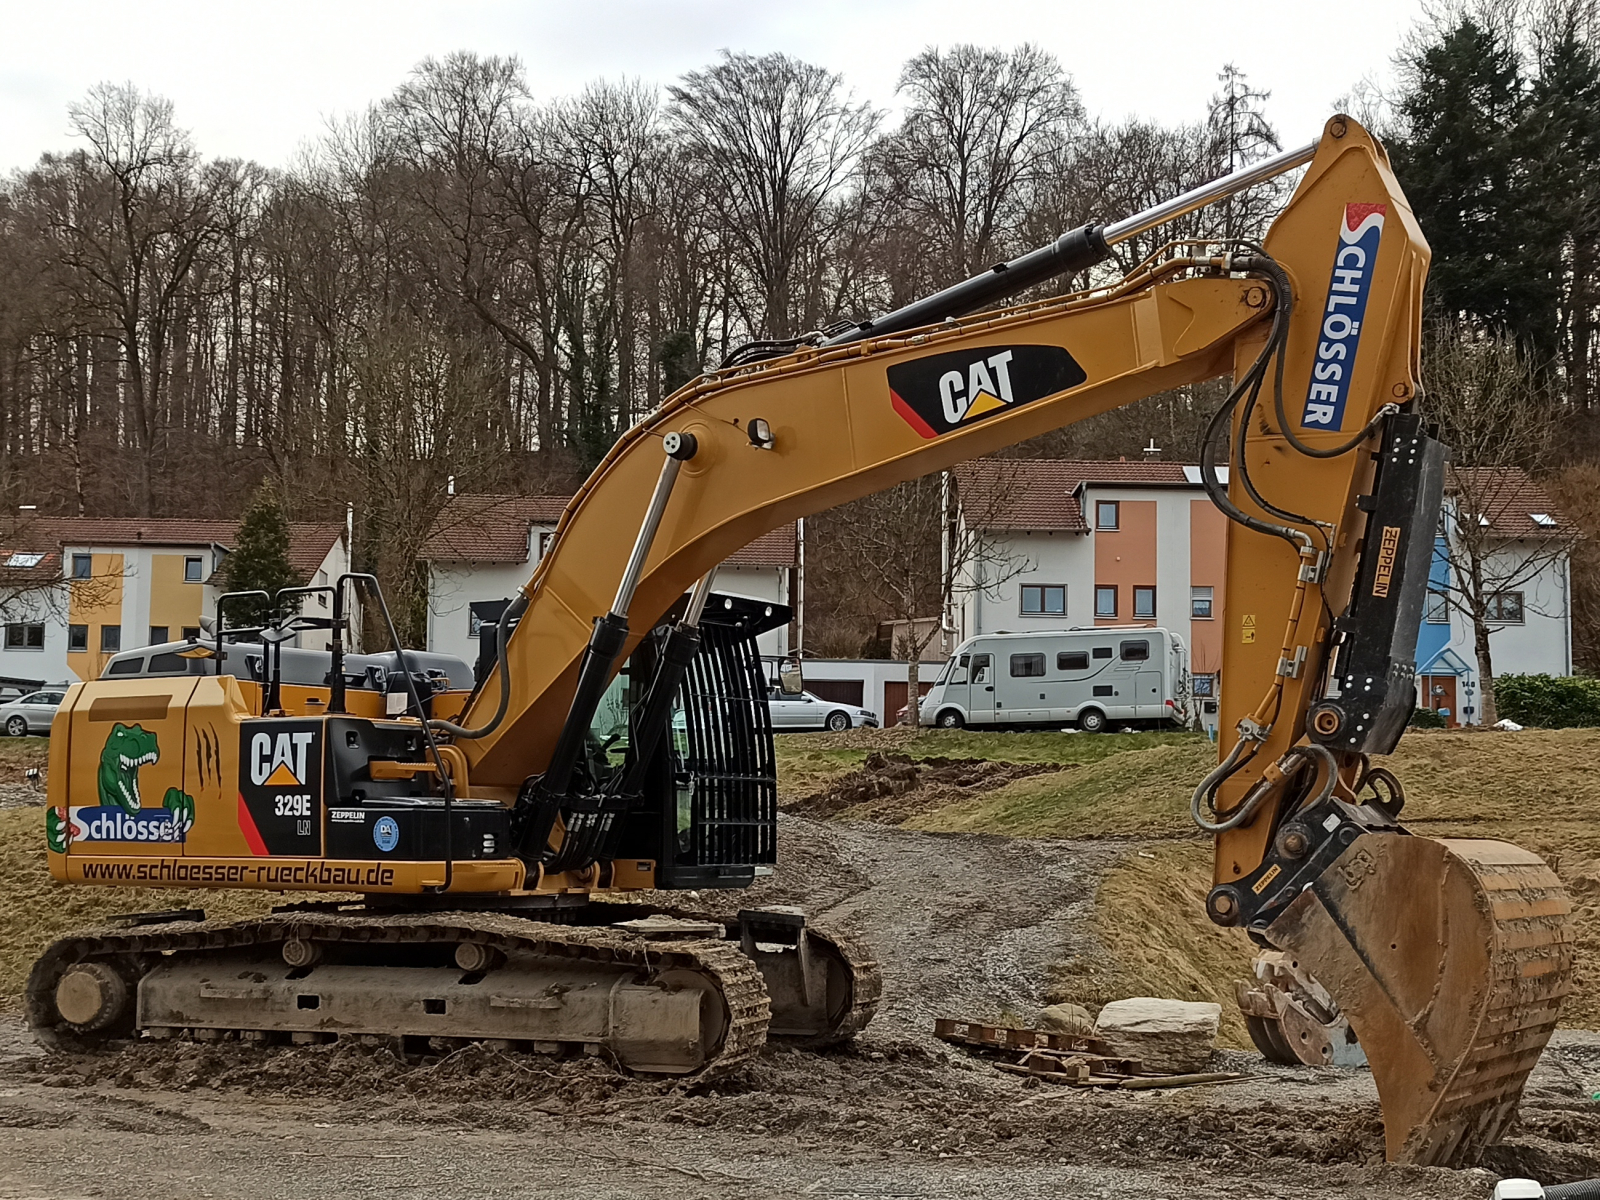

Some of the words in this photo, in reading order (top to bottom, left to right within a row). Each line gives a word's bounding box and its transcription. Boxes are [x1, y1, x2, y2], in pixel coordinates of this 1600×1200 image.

[1304, 206, 1385, 425] SCHLÖSSER
[939, 350, 1013, 424] CAT
[1375, 529, 1398, 595] ZEPPELIN
[251, 732, 313, 786] CAT
[274, 795, 311, 816] 329E
[331, 811, 365, 819] ZEPPELIN
[297, 820, 311, 835] LN
[82, 859, 394, 886] www.schloesser-rueckbau.de
[1254, 866, 1278, 892] ZEPPELIN
